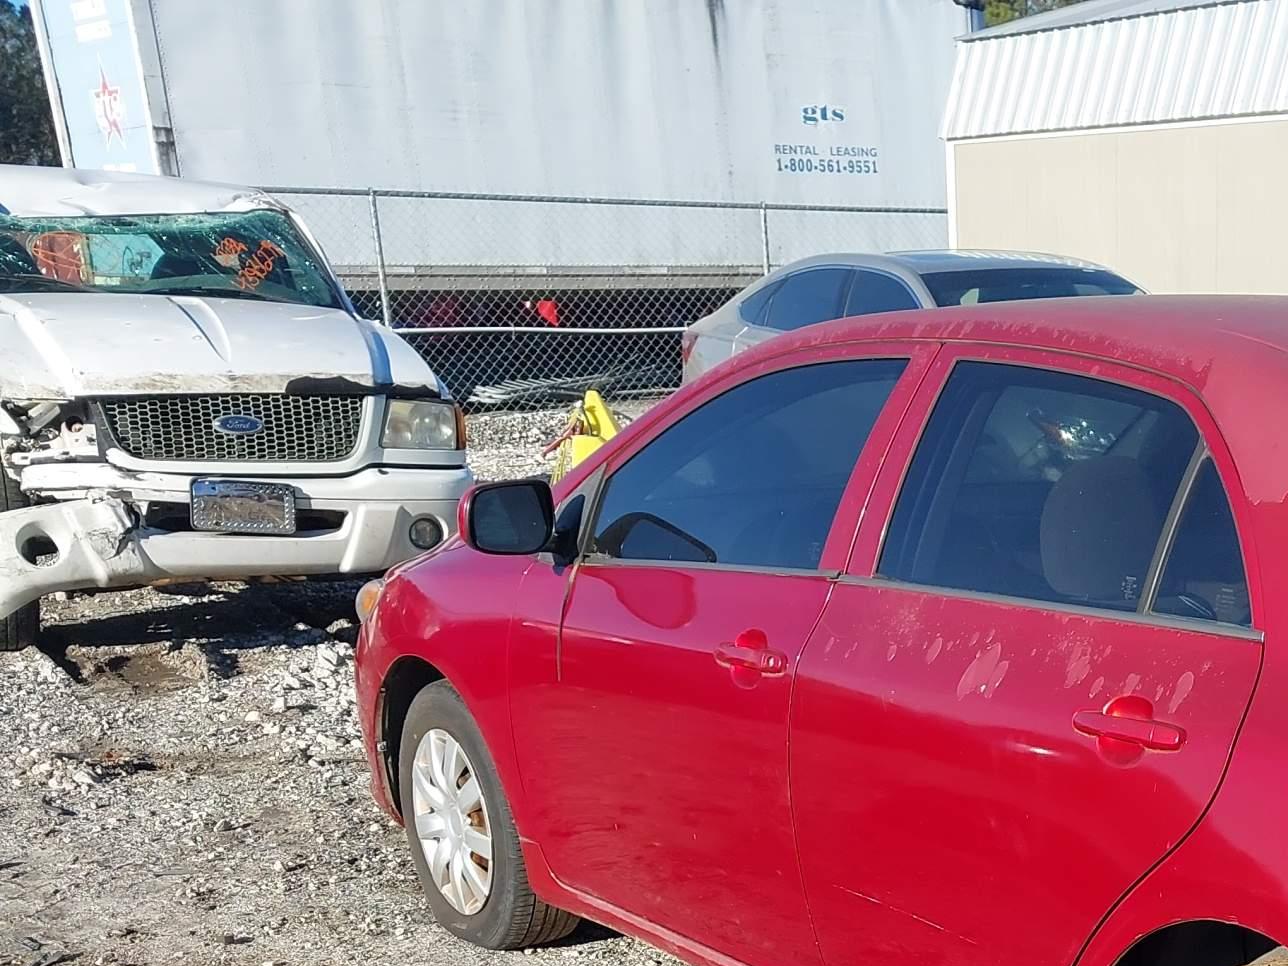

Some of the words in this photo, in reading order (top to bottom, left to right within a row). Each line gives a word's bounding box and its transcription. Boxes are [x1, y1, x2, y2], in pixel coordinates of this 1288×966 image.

[802, 104, 845, 125] gts
[774, 144, 819, 156] RENTAL
[830, 146, 878, 157] LEASING
